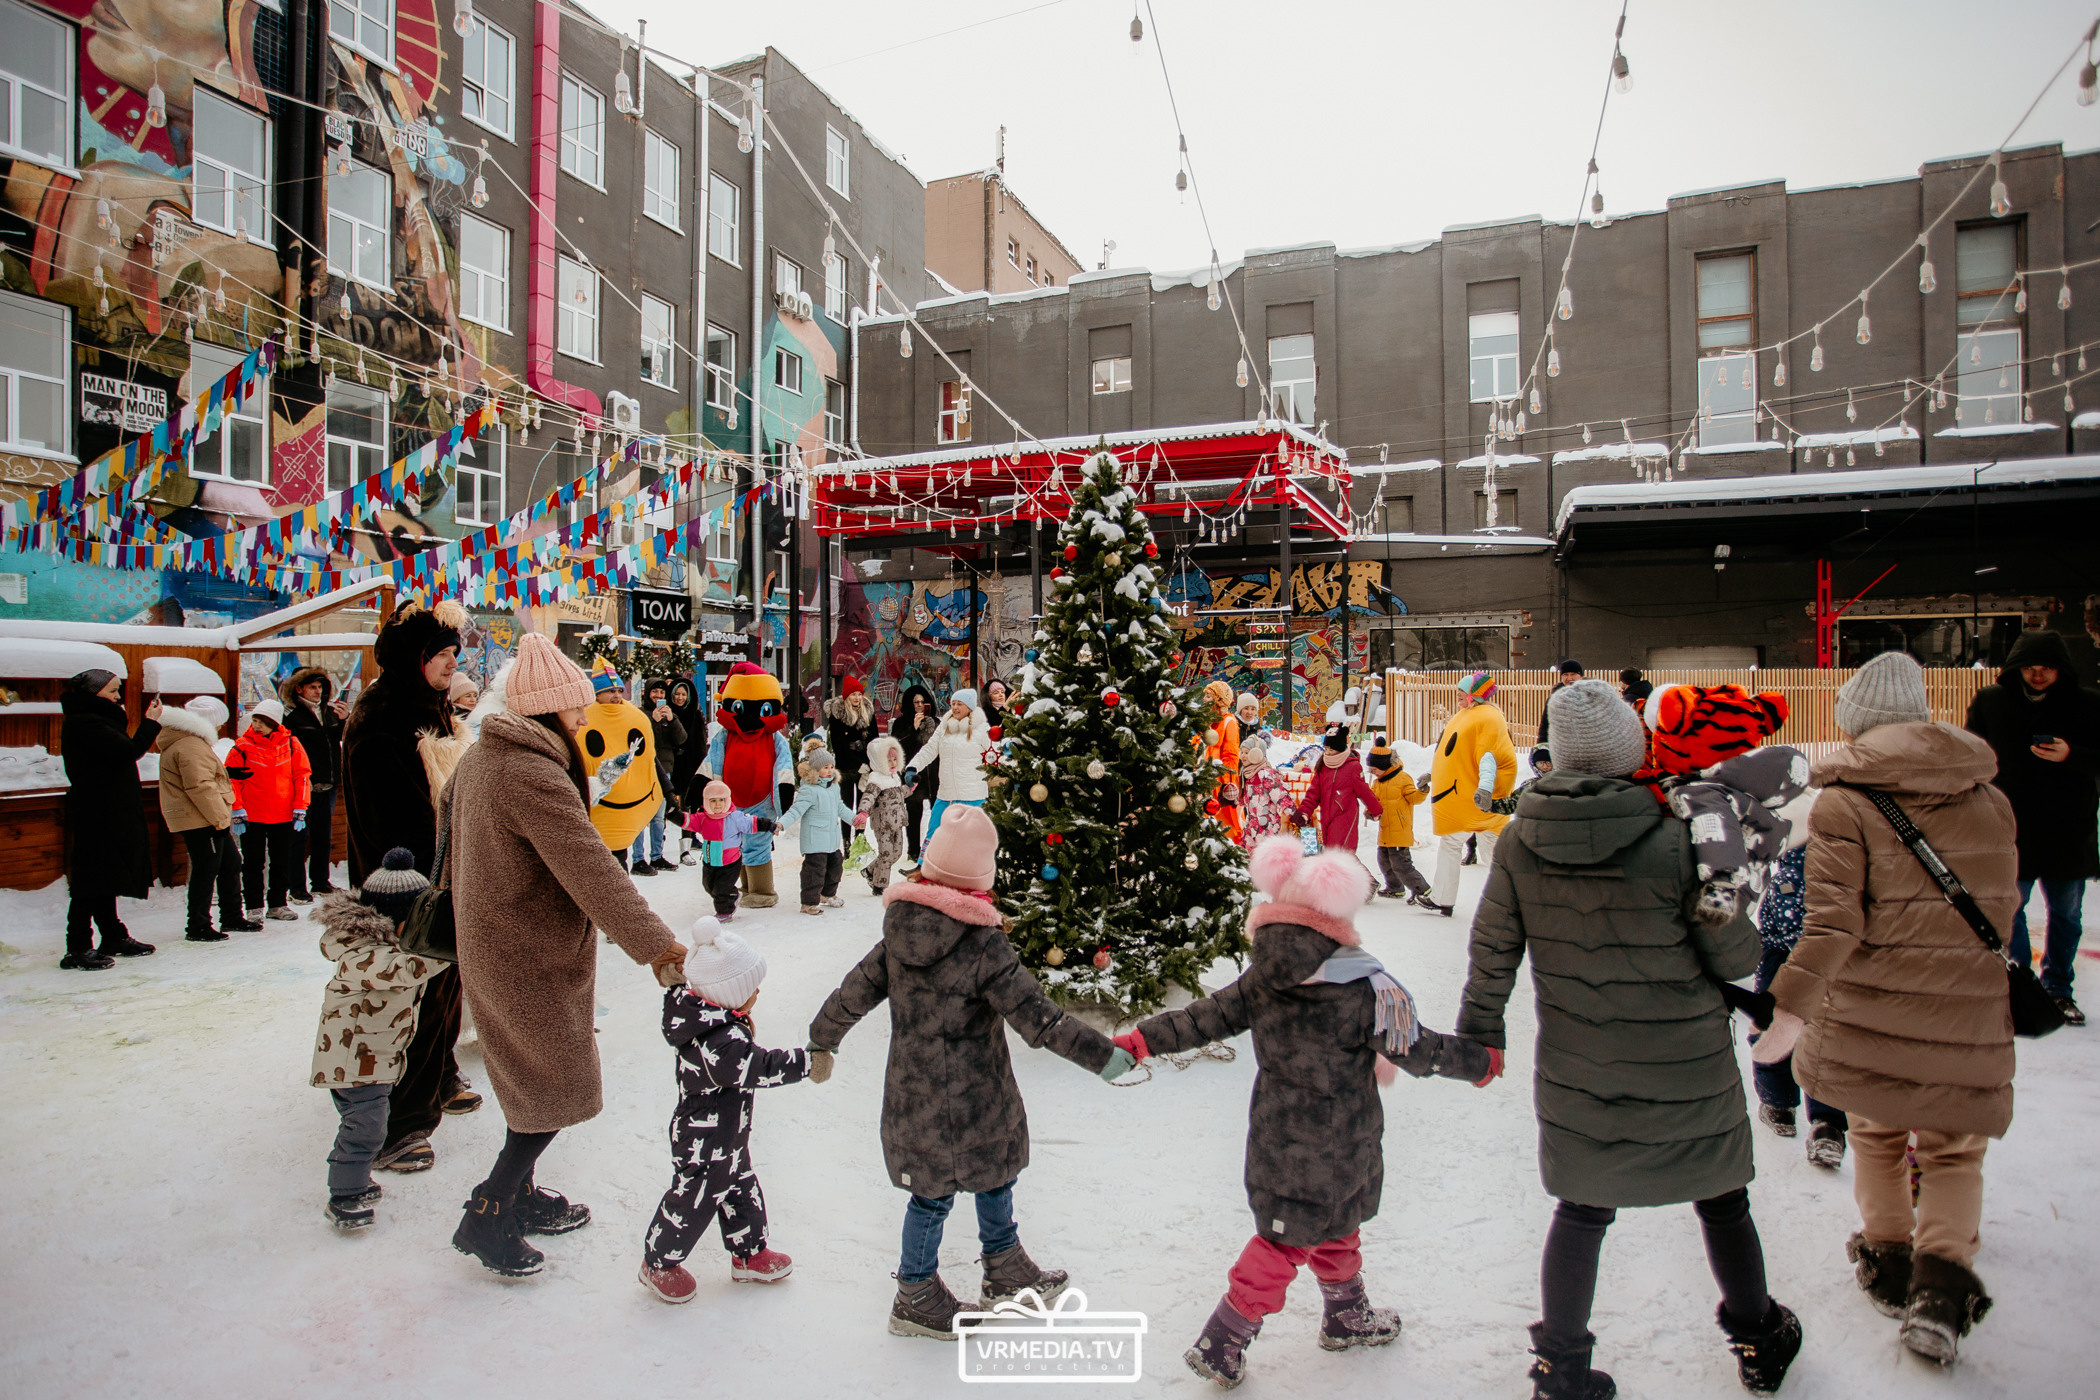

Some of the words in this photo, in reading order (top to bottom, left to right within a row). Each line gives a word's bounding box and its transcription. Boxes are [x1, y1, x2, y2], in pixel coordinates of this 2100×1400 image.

[83, 375, 116, 395] MAN
[120, 383, 138, 399] ON
[142, 388, 166, 405] THE
[126, 399, 165, 419] MOON
[560, 600, 580, 614] gives
[582, 606, 602, 622] birth
[700, 629, 749, 646] jawsspot
[1255, 642, 1281, 650] CHILL
